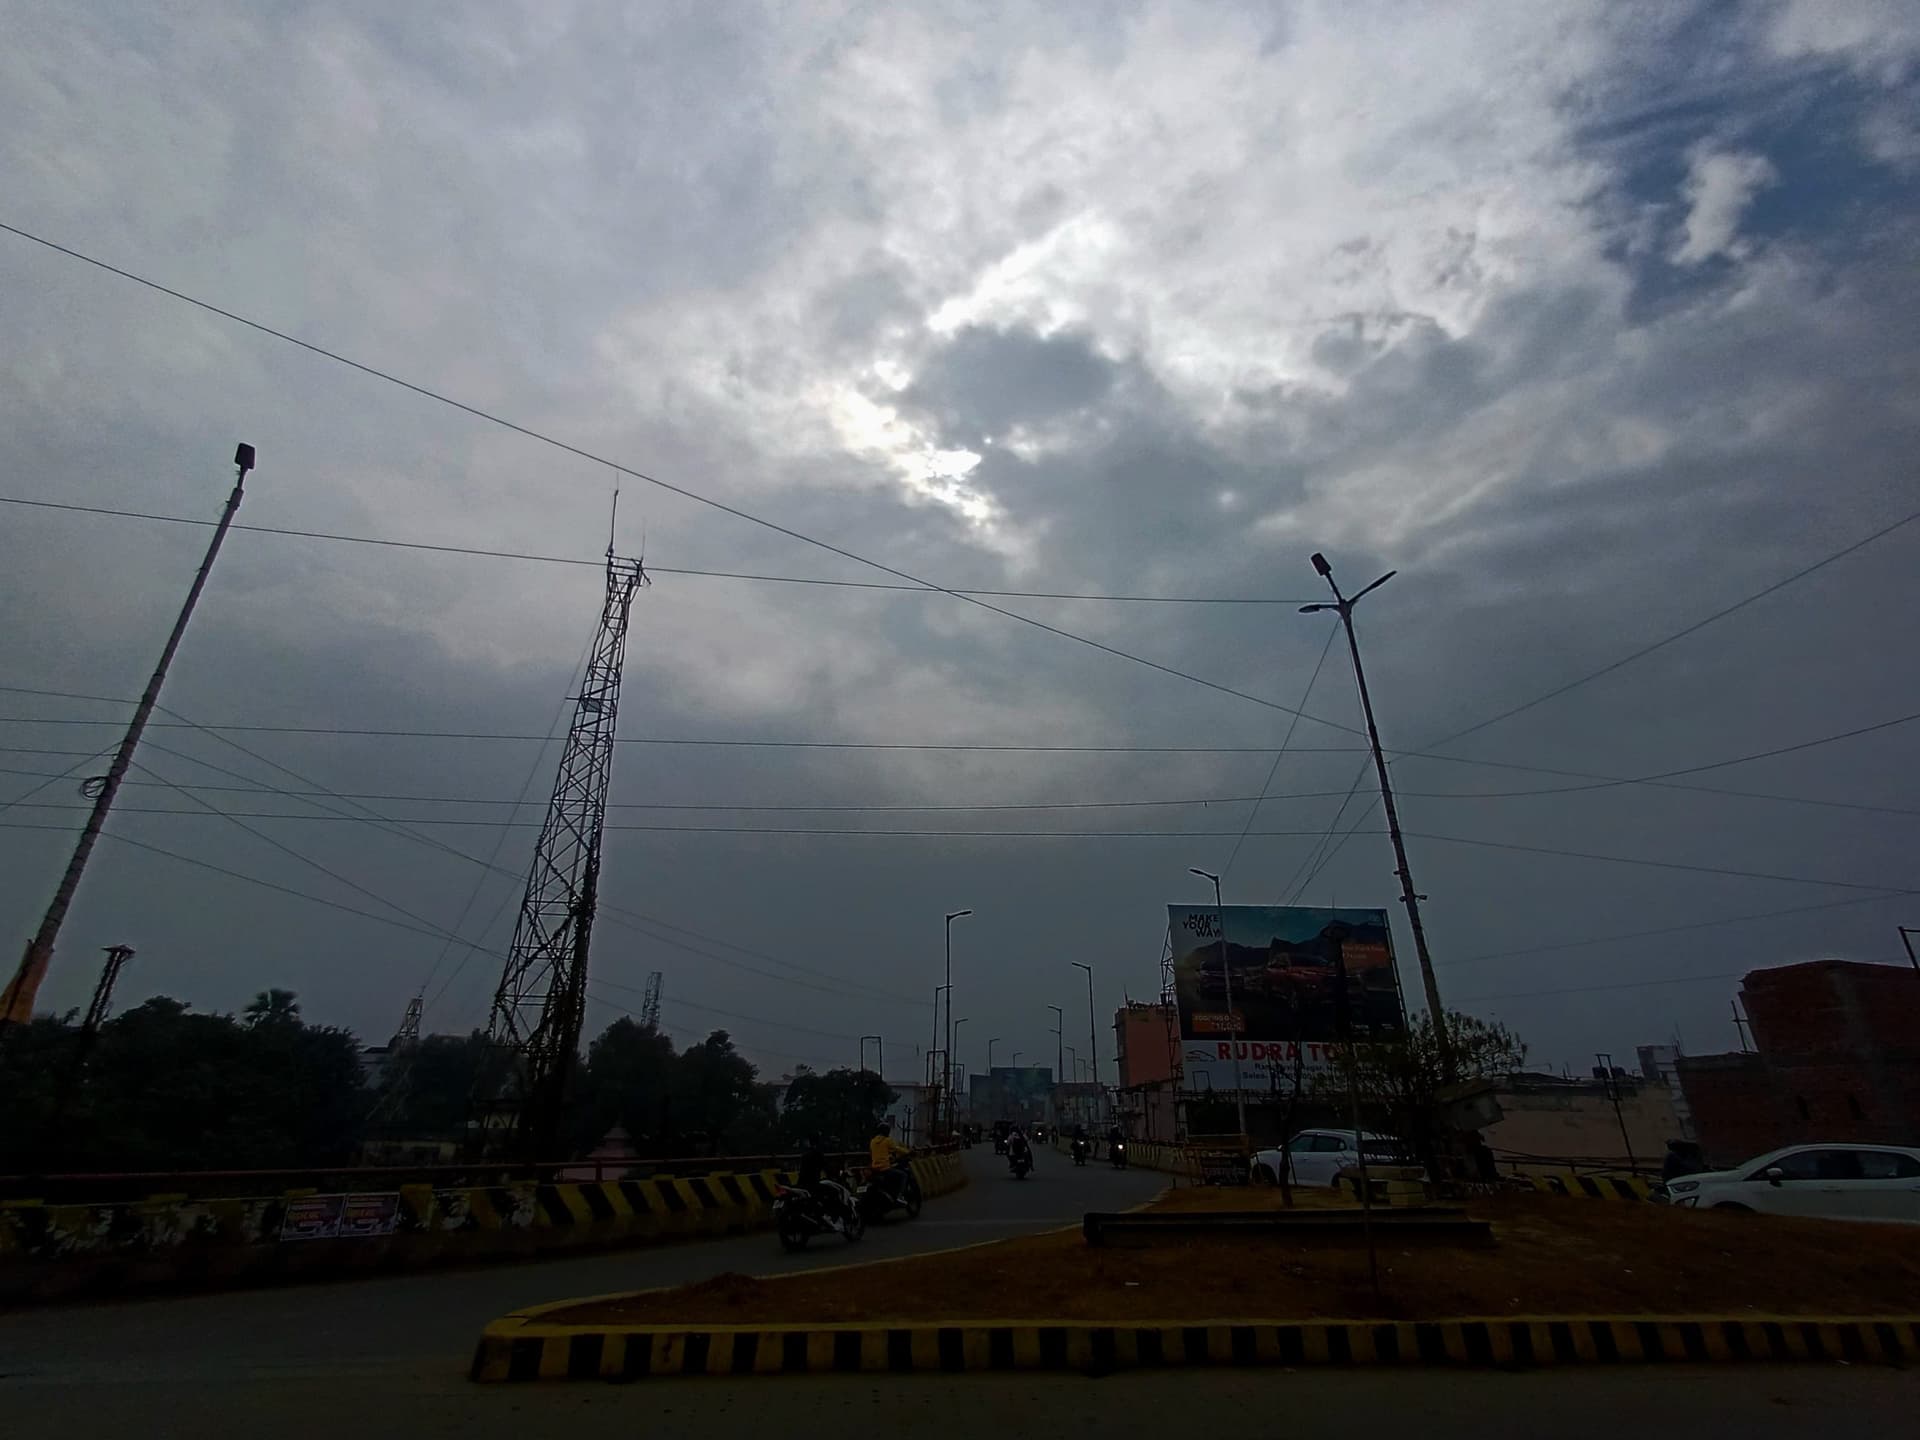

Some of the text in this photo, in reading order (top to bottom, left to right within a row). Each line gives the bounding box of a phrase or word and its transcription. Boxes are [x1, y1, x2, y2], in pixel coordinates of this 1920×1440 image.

[1188, 914, 1218, 922] MAKE
[1183, 920, 1210, 929] YOUR
[1195, 927, 1220, 937] WAY
[1218, 1042, 1302, 1060] RUDRA
